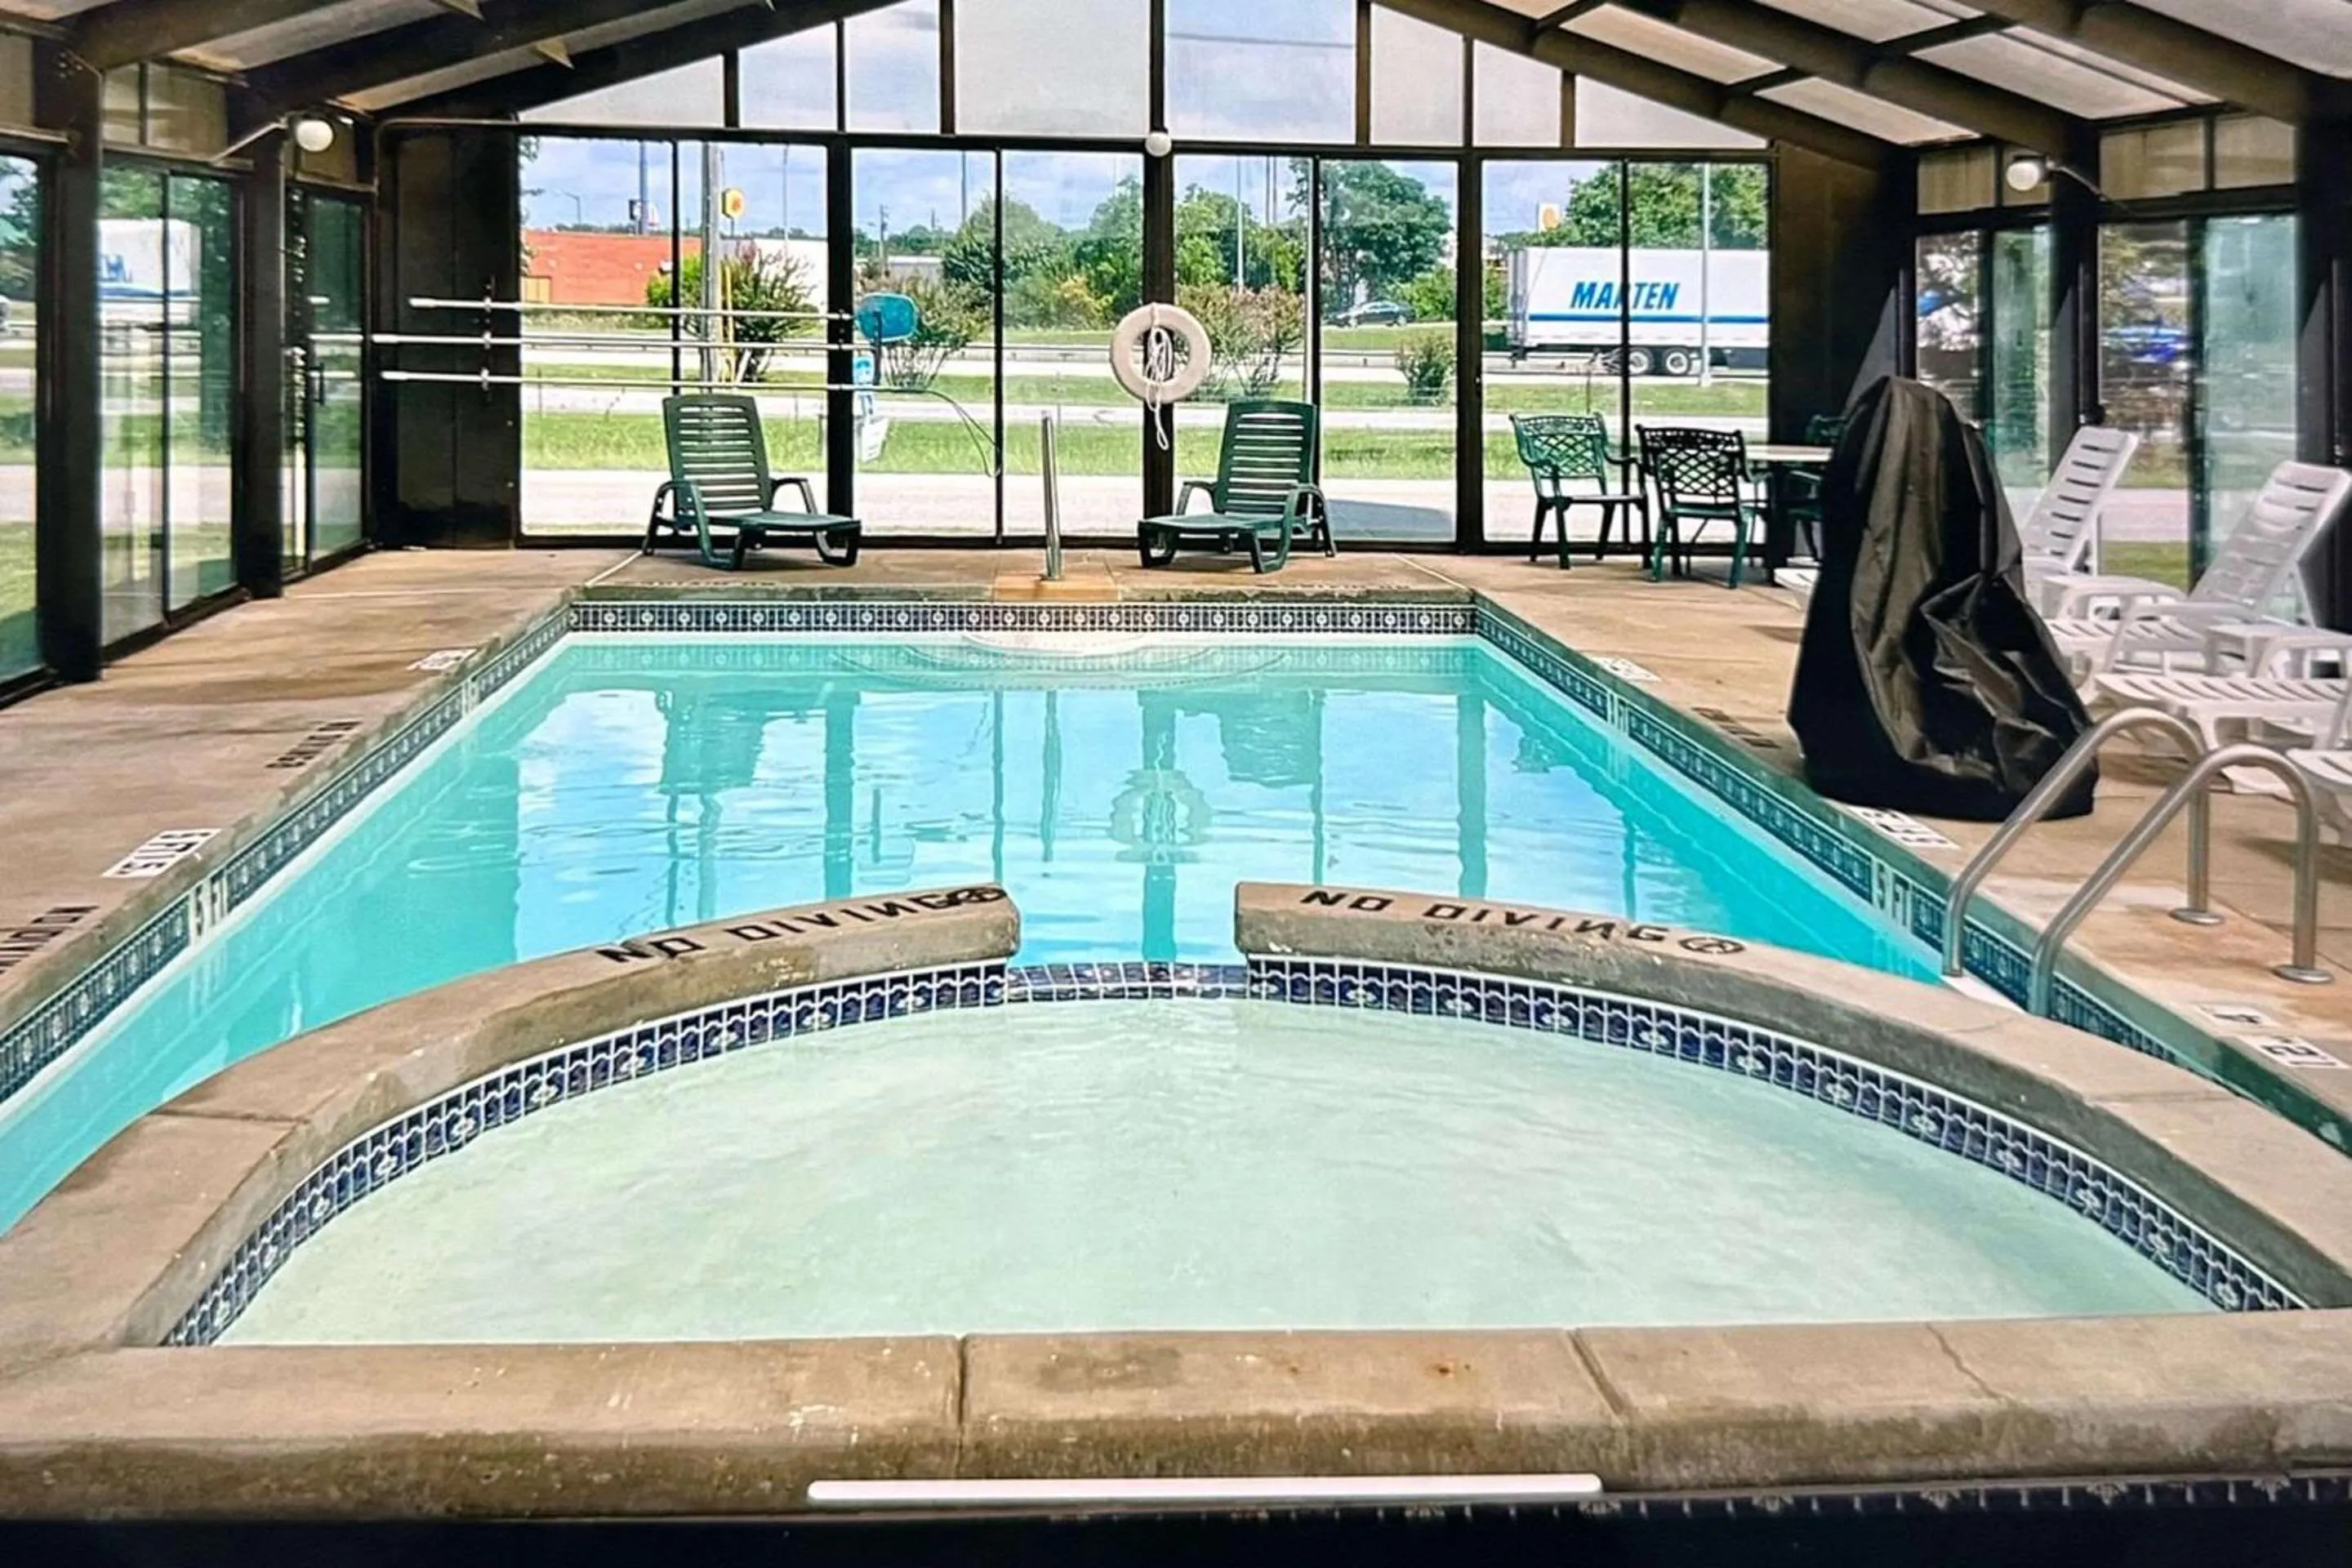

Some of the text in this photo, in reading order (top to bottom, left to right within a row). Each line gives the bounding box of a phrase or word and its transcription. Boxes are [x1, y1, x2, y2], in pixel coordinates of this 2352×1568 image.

[596, 894, 954, 962] NO DIVING
[1299, 891, 1668, 941] NO DIVING
